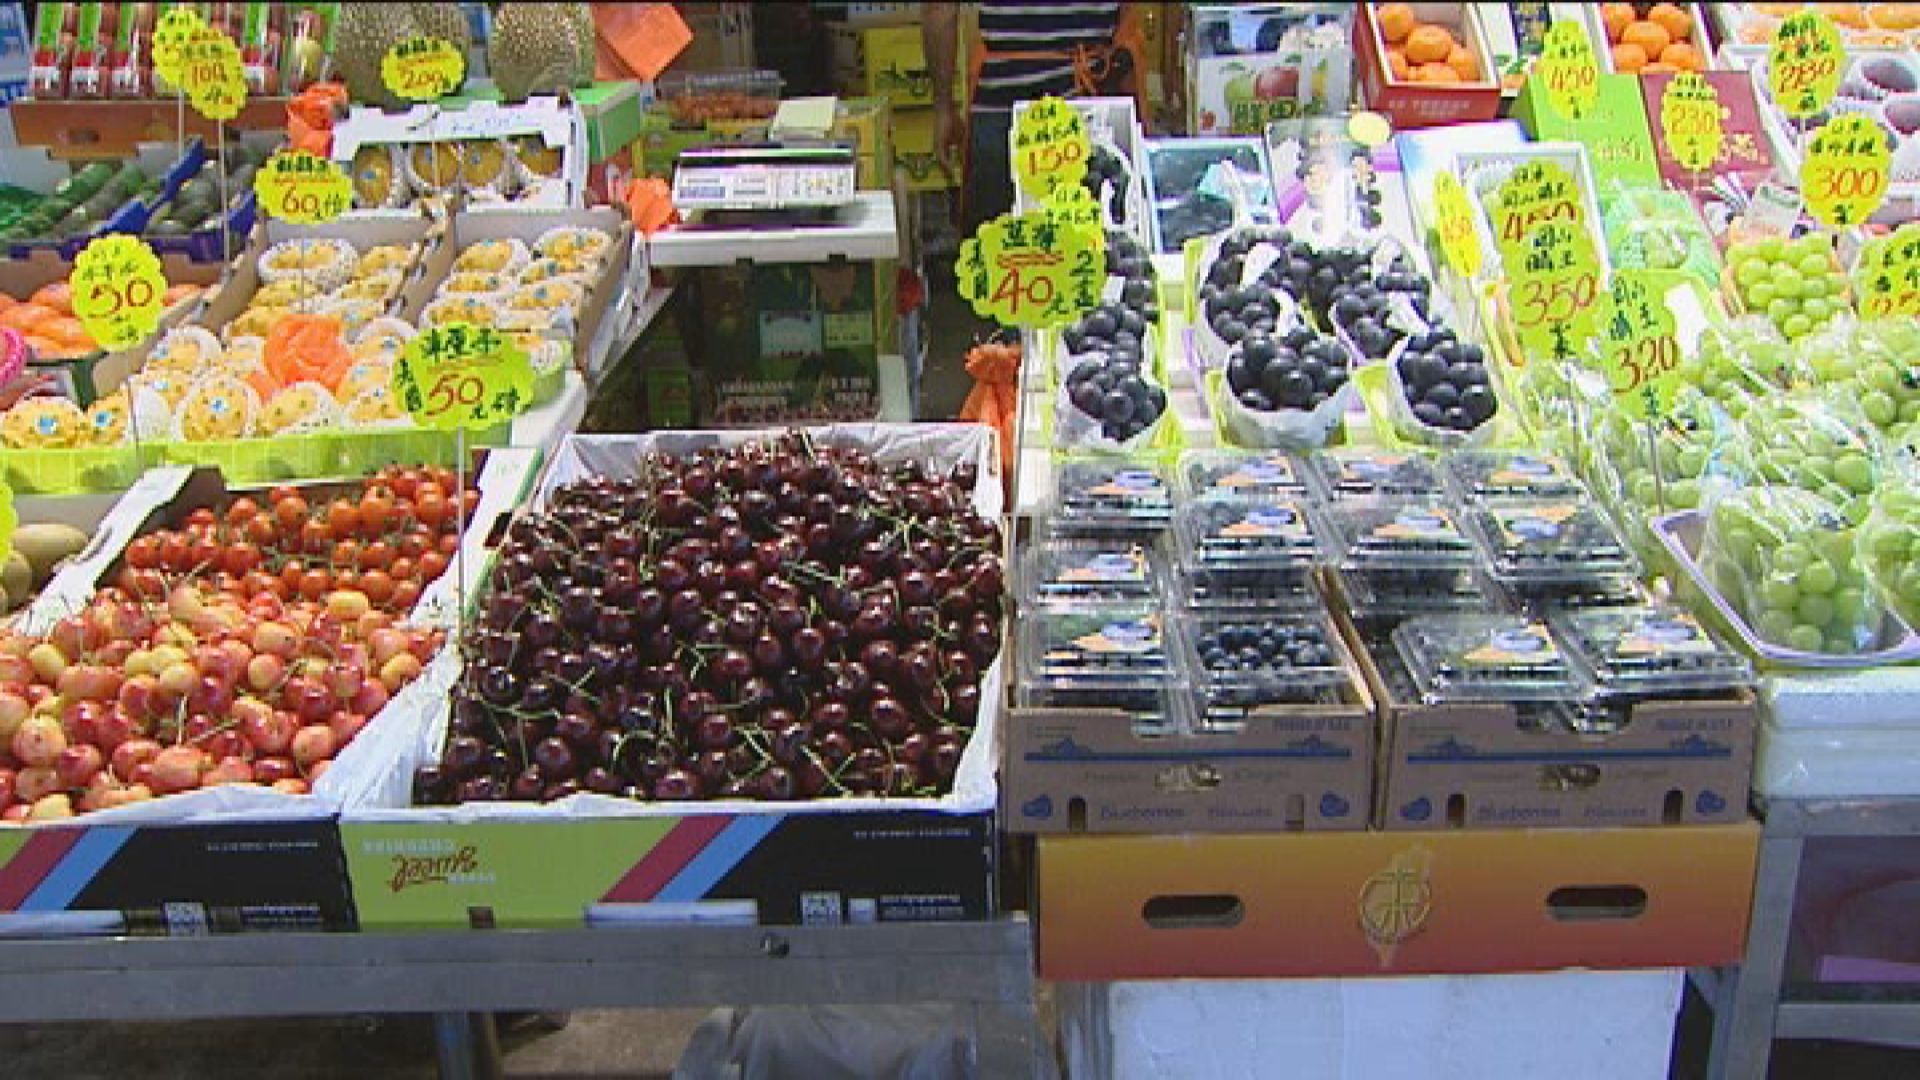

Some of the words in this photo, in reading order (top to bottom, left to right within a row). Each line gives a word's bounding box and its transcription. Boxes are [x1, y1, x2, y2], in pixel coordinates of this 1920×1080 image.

[282, 185, 319, 215] 60
[1813, 165, 1879, 199] 300
[87, 276, 154, 319] 50
[991, 267, 1055, 315] 40
[1518, 272, 1597, 328] 350
[1613, 335, 1679, 395] 320
[424, 373, 484, 417] 50
